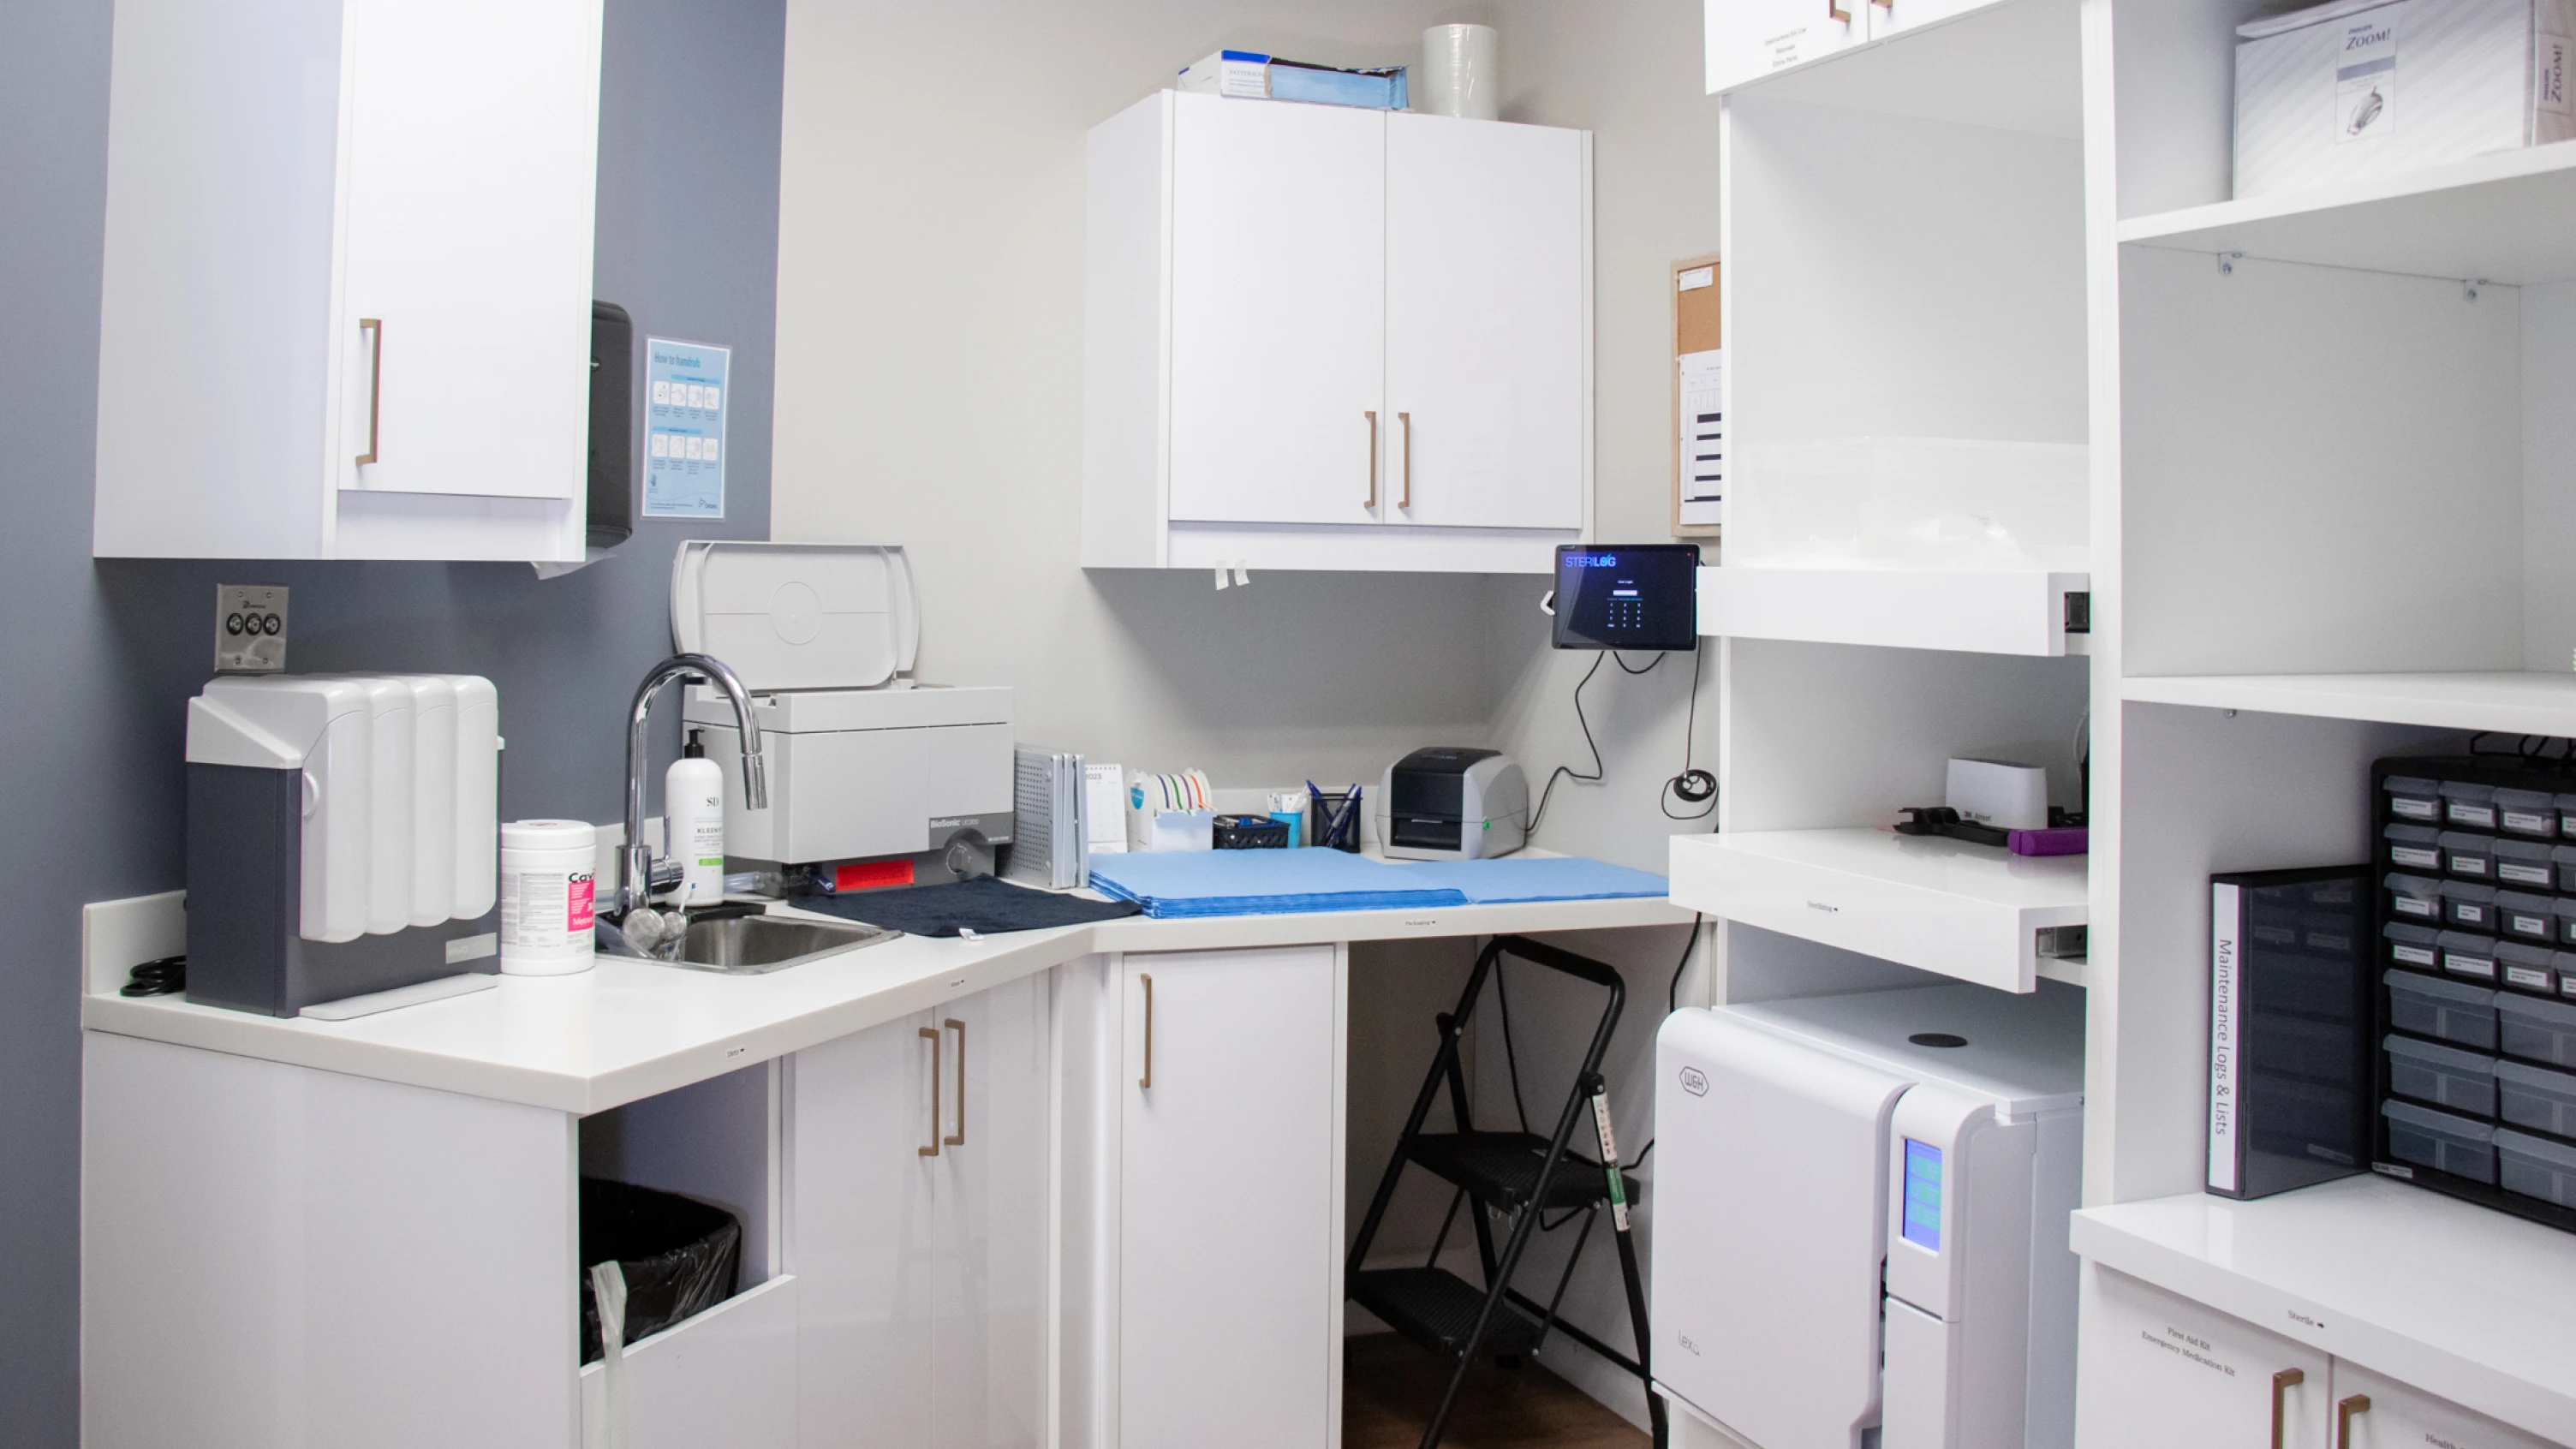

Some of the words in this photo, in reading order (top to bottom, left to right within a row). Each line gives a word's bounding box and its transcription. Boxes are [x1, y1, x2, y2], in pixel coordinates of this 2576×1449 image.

[2346, 27, 2390, 51] ZOOM!
[2551, 45, 2562, 103] ZOOM!
[2217, 939, 2233, 1041] Maintenance
[2215, 1047, 2230, 1080] Logs
[2215, 1084, 2230, 1096] &
[2215, 1102, 2229, 1136] Lists
[2287, 1310, 2314, 1327] Sterile
[2142, 1331, 2181, 1354] Emergency
[2182, 1348, 2223, 1371] Medication
[2224, 1365, 2235, 1377] Kit
[2168, 1327, 2185, 1340] First
[2186, 1335, 2198, 1346] Aid
[2200, 1340, 2211, 1351] Kit
